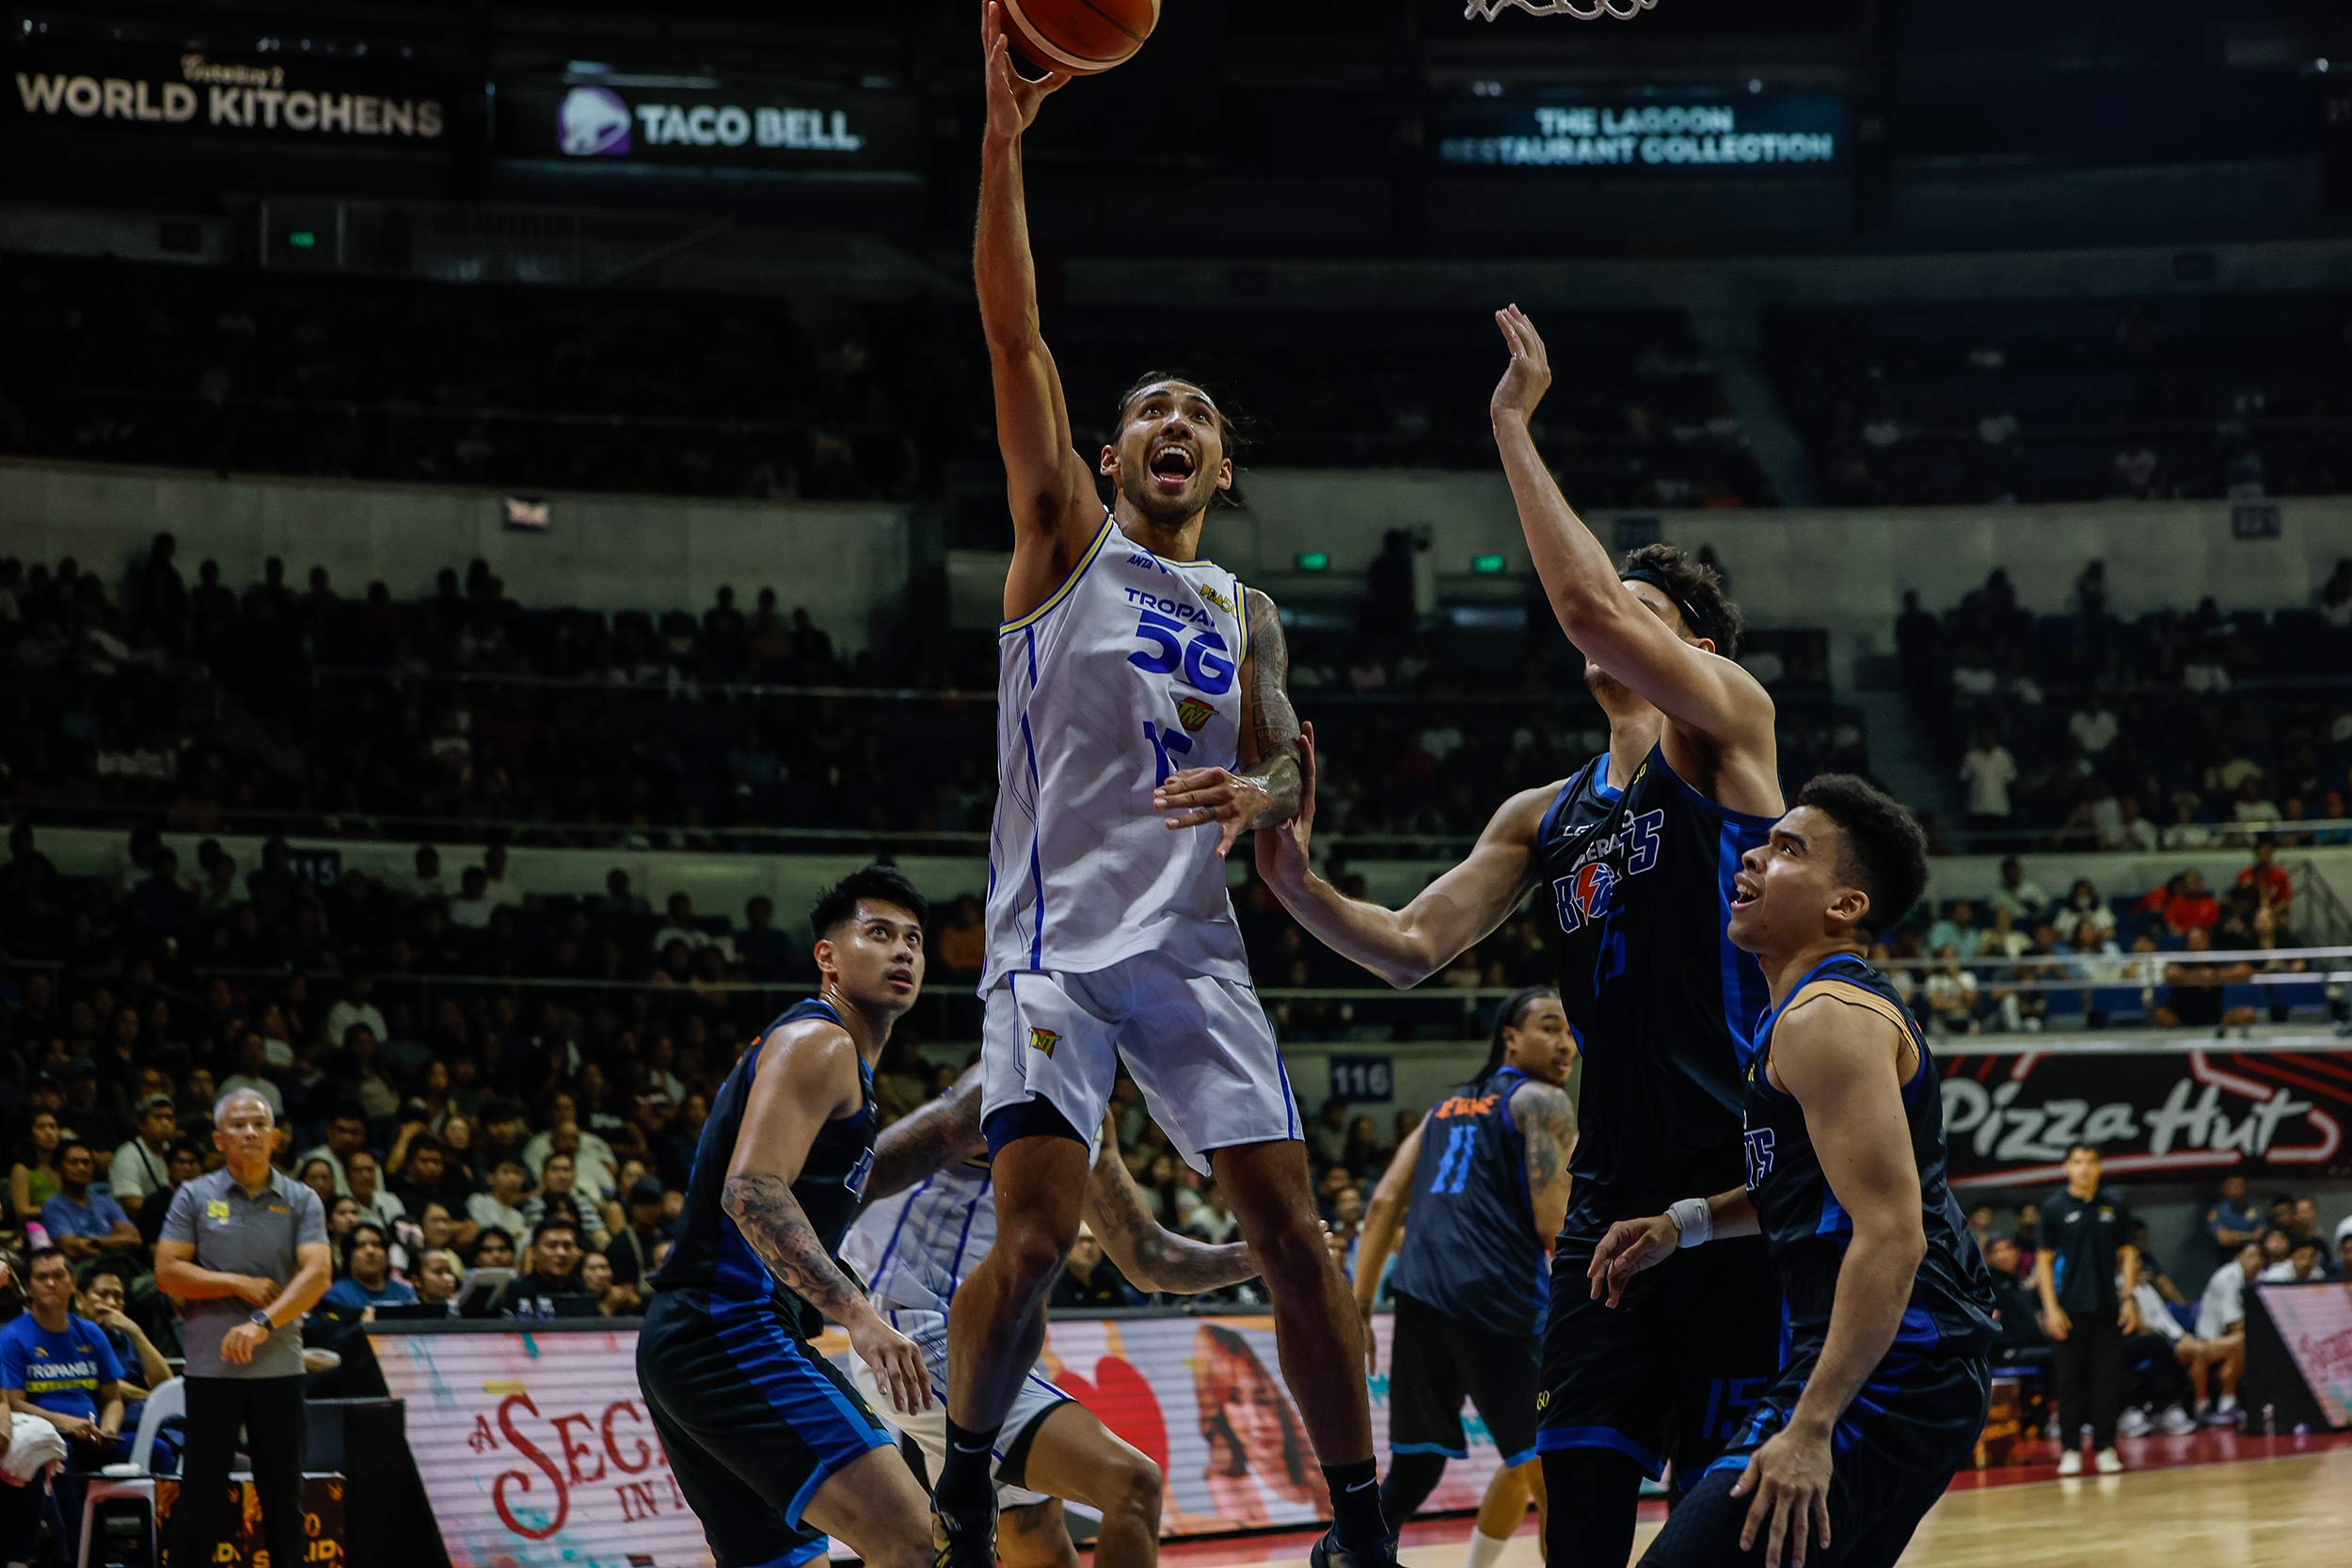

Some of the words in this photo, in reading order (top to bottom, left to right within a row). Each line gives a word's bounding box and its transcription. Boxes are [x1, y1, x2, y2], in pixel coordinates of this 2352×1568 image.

[15, 71, 198, 122] WORLD
[209, 85, 444, 138] KITCHENS
[634, 103, 752, 146] TACO
[755, 106, 863, 151] BELL
[1535, 106, 1597, 136] THE
[1601, 106, 1736, 136] LAGOON
[1640, 132, 1836, 164] COLLECTION
[1127, 554, 1153, 570] ANTA
[1124, 587, 1216, 627] TROPA
[1127, 610, 1235, 695] 5G
[1178, 700, 1220, 726] TNT
[1332, 1063, 1389, 1097] 116
[1940, 1077, 2139, 1162] Pizza
[2144, 1077, 2313, 1156] Hut
[1430, 1124, 1479, 1195] 11
[1701, 1377, 1769, 1440] 15
[469, 1415, 500, 1454] A
[493, 1389, 669, 1540] SEC
[615, 1480, 660, 1523] IN
